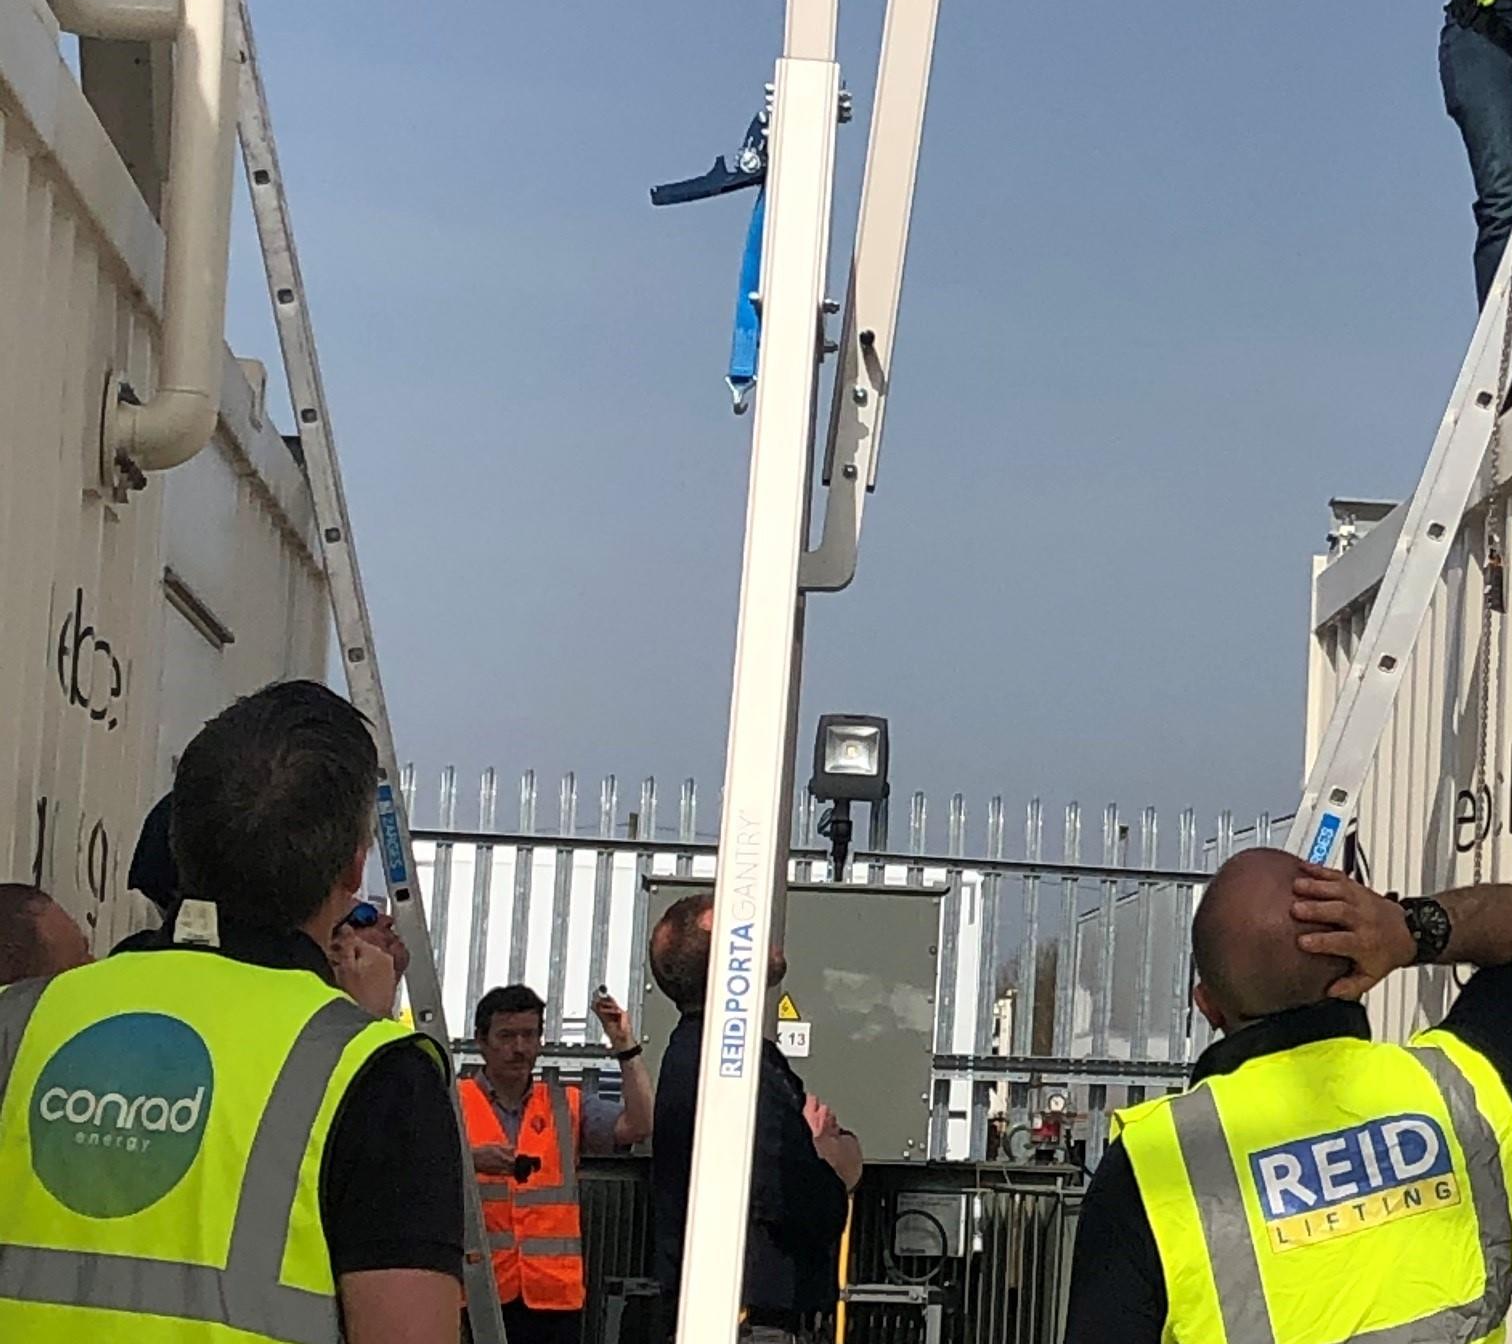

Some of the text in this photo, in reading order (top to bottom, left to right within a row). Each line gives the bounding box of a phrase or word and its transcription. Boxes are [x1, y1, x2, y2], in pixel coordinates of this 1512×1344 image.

[720, 1017, 747, 1077] REID
[40, 1086, 205, 1133] conrad
[74, 1131, 151, 1152] energy
[1258, 1119, 1440, 1215] REID
[1276, 1181, 1452, 1244] LIFTING
